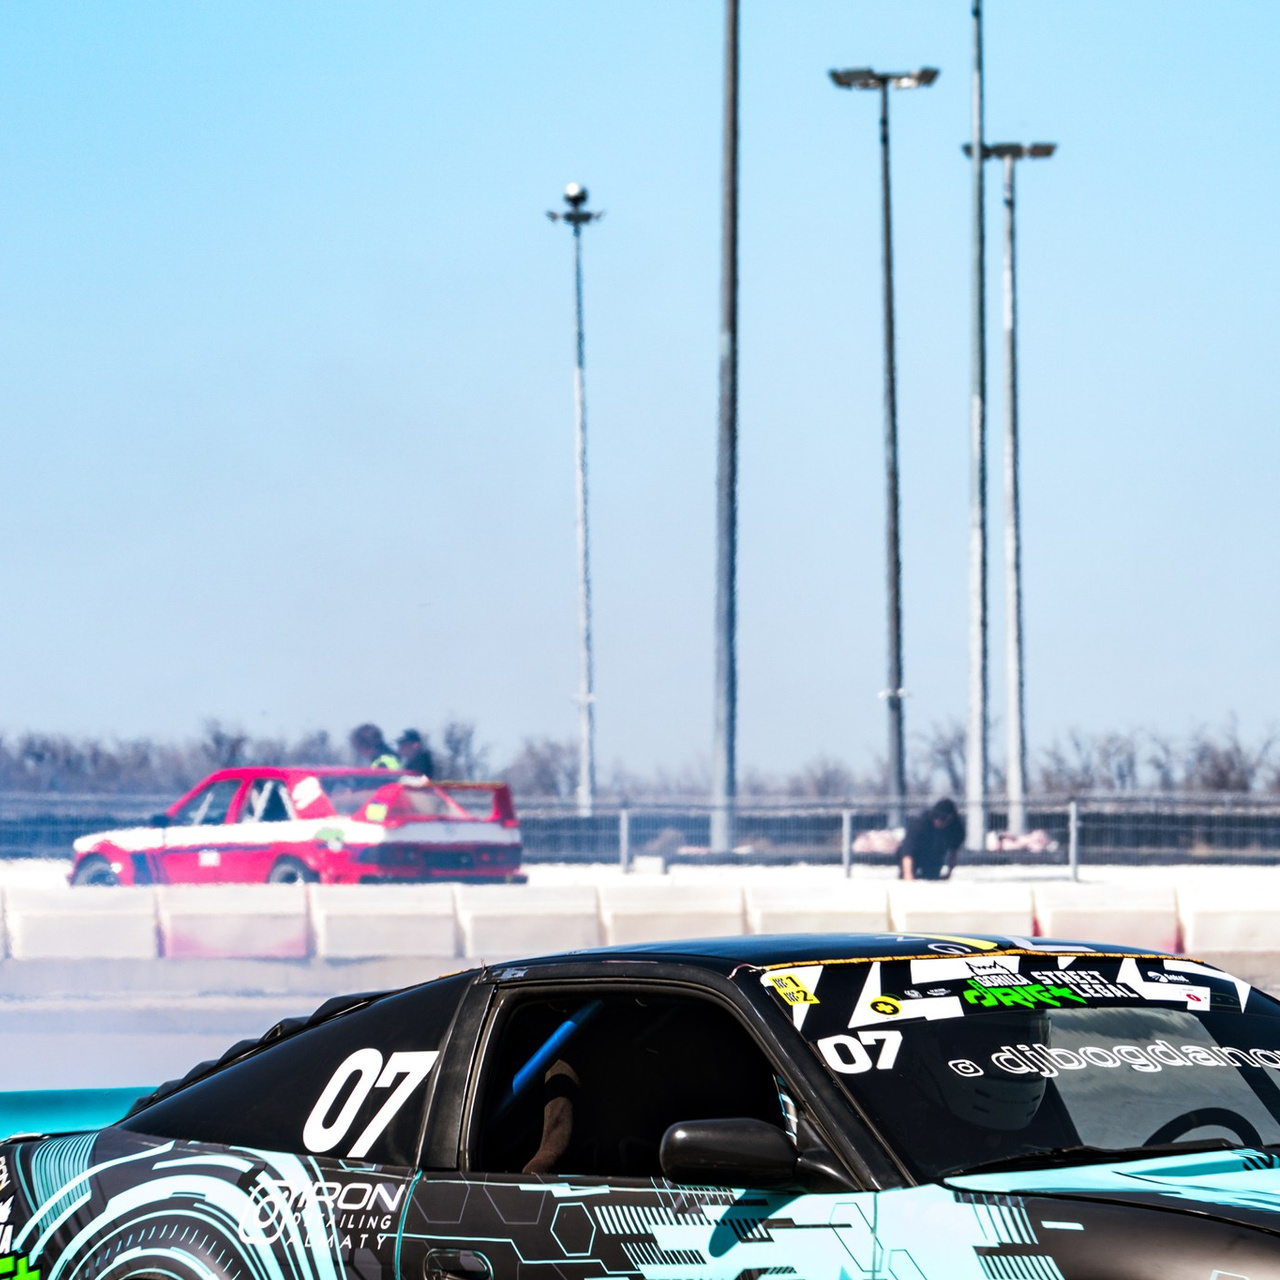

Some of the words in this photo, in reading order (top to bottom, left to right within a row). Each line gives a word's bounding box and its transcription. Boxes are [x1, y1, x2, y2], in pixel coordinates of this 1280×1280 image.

[973, 974, 1032, 987] GORILLA
[1030, 971, 1108, 984] STREET
[1068, 983, 1139, 997] LEGAL
[817, 1030, 903, 1074] 07
[303, 1047, 440, 1159] 07
[297, 1181, 406, 1212] IRON
